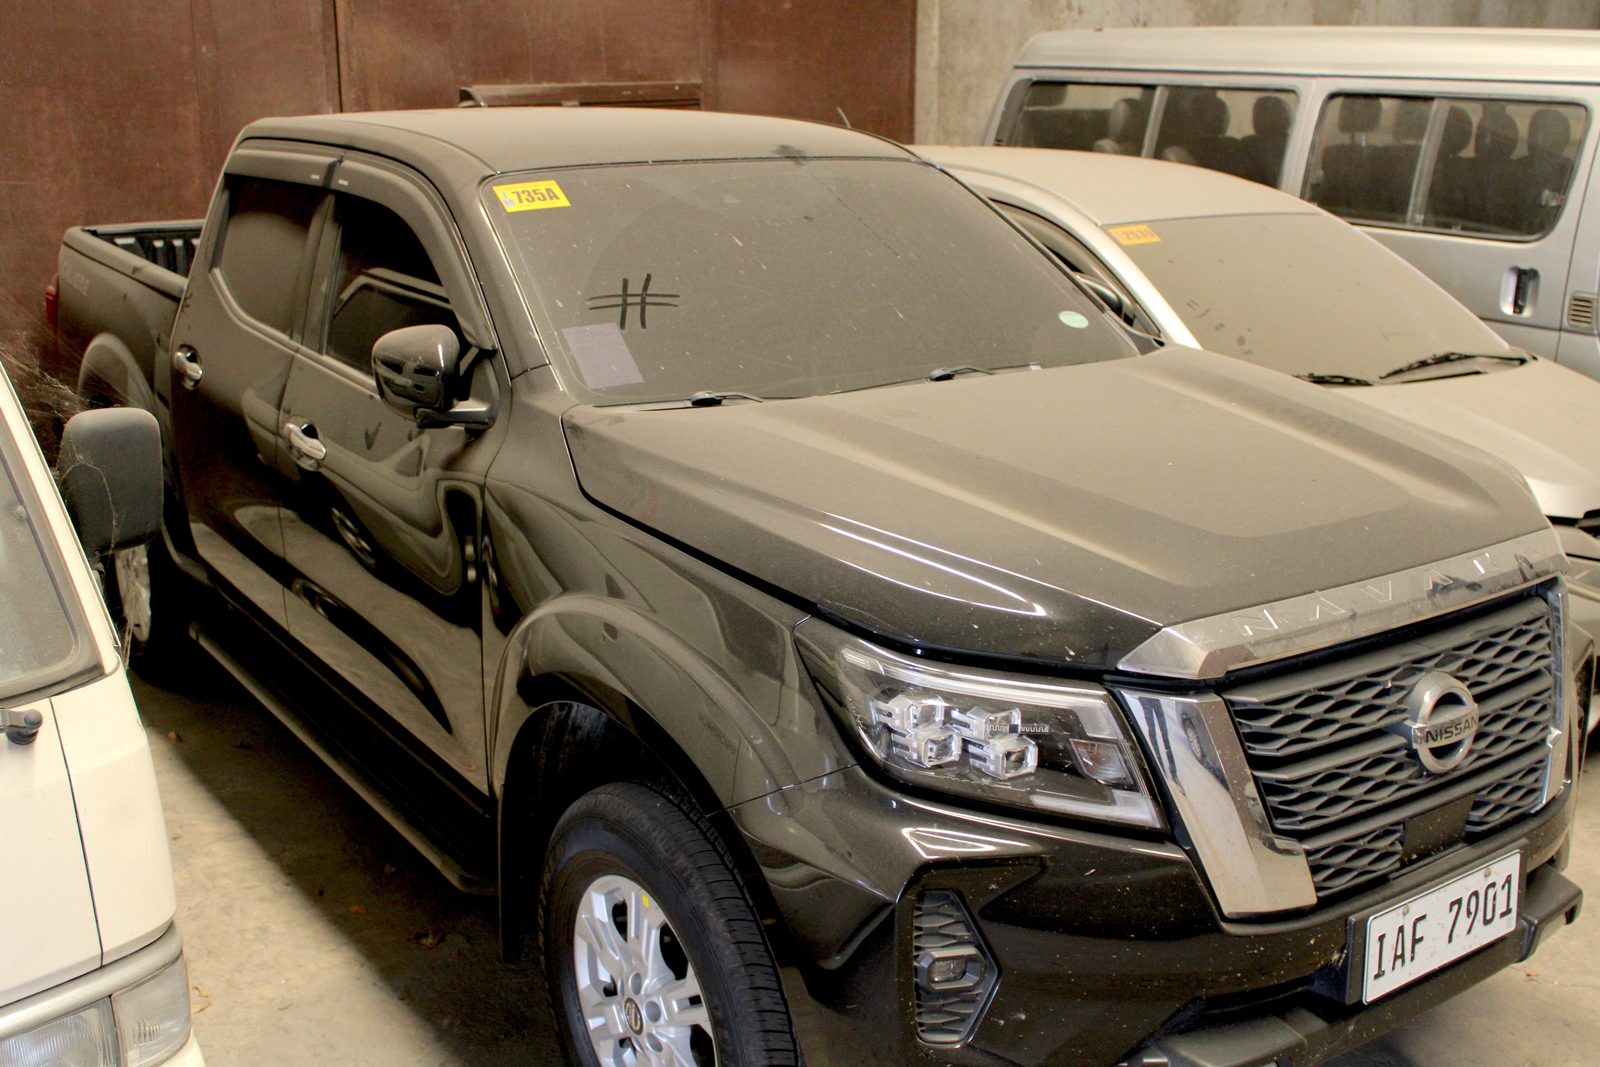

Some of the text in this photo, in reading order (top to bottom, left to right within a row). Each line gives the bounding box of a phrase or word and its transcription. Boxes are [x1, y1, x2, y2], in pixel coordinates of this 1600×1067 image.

[511, 187, 561, 204] 735A
[1425, 715, 1478, 743] NISSAN
[1374, 873, 1513, 980] IAF 7901
